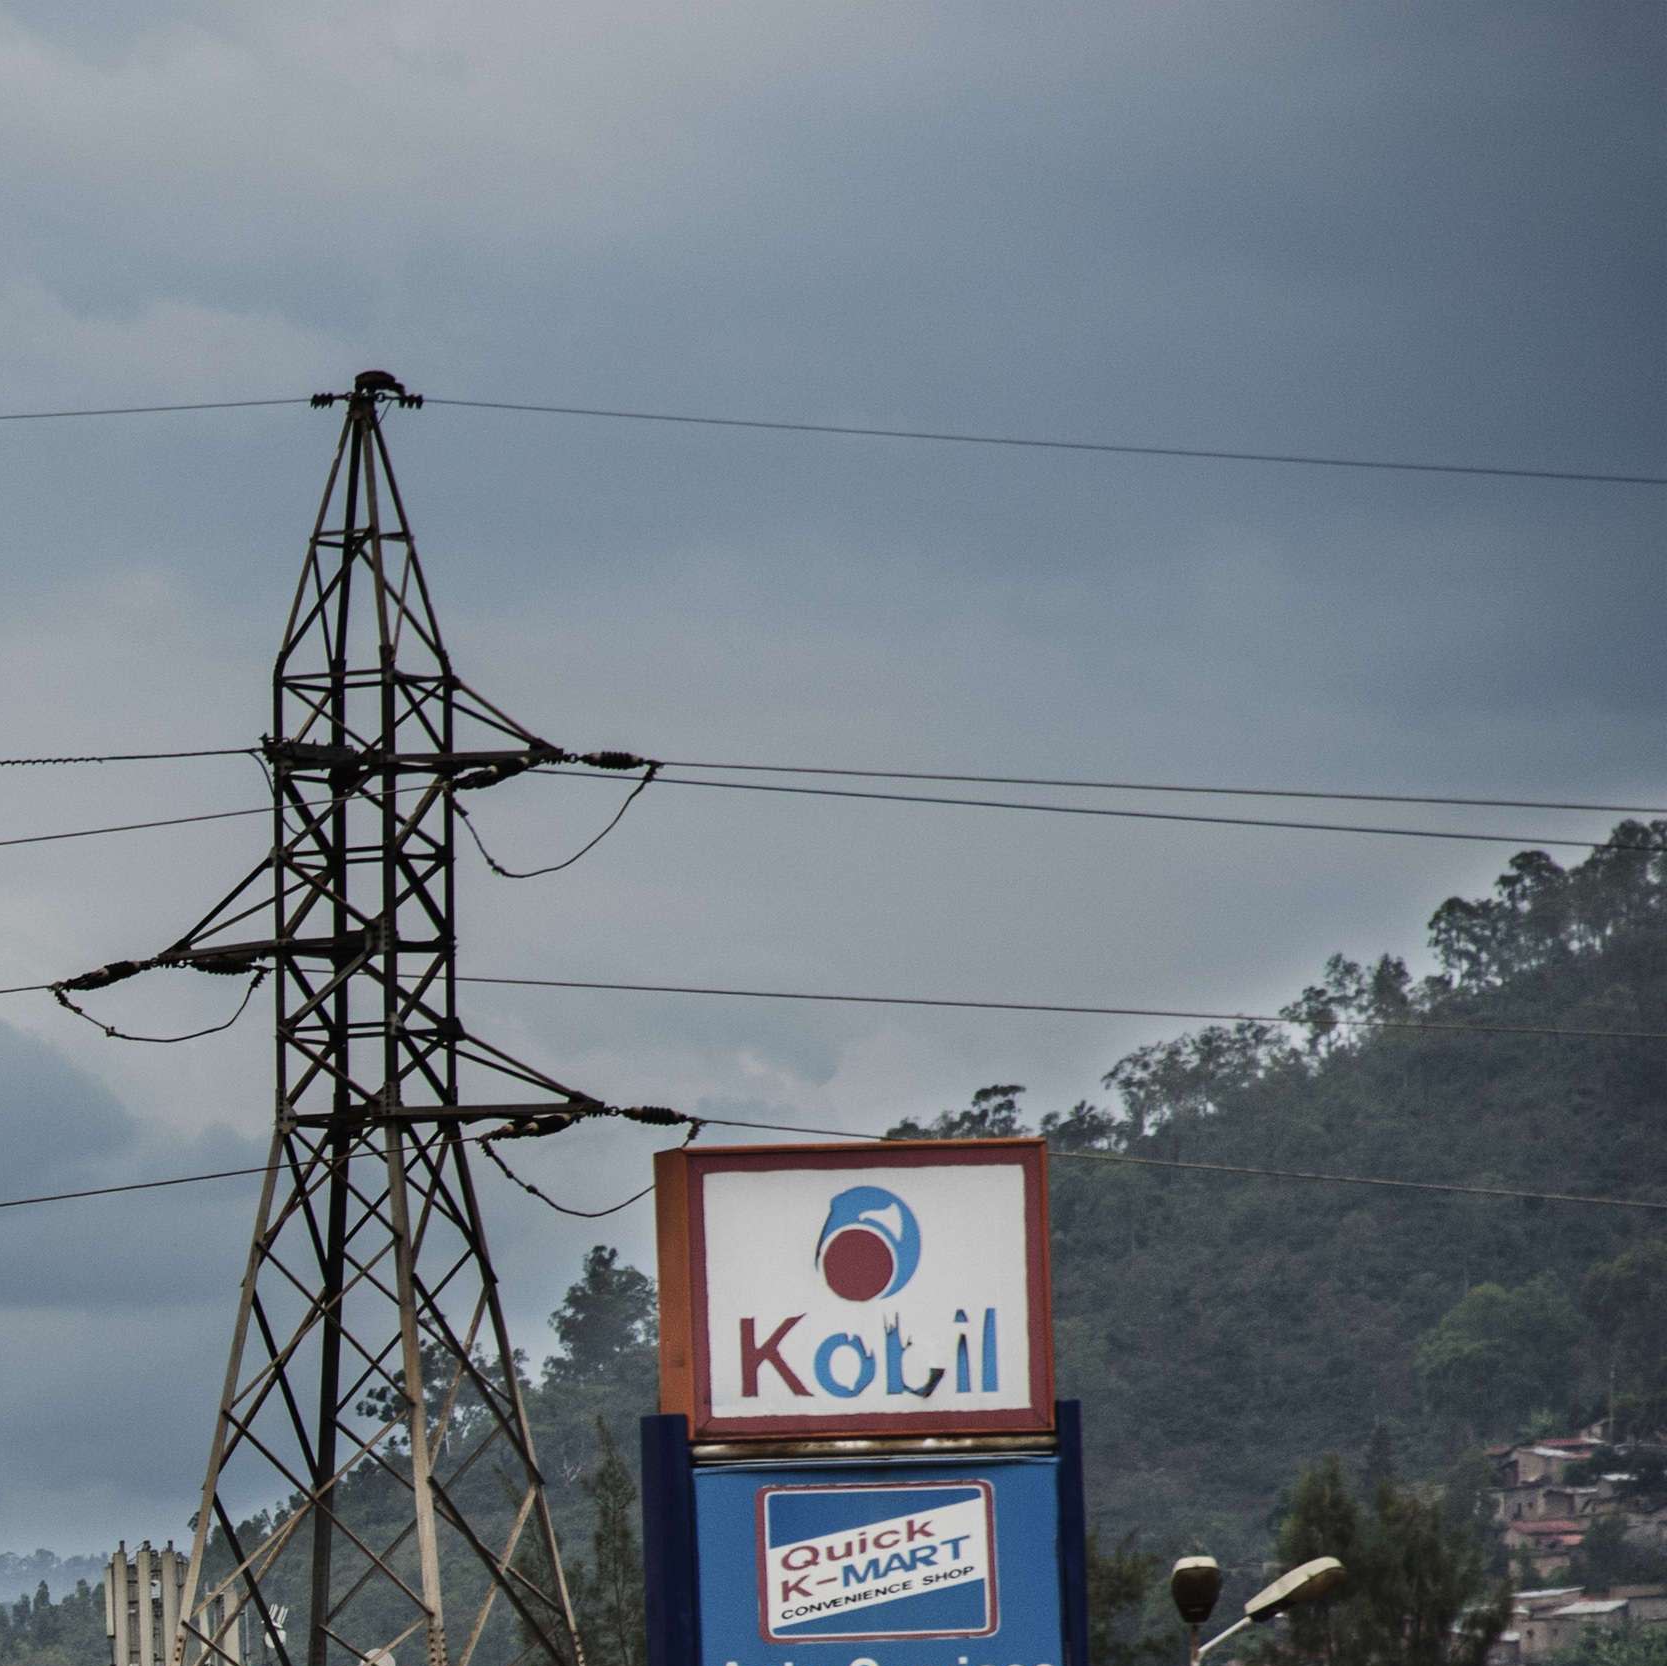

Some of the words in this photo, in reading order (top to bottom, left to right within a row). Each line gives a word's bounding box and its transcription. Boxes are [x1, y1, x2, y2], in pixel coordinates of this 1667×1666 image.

[779, 1518, 935, 1573] Quick
[781, 1535, 971, 1603] K-MART
[781, 1580, 914, 1620] CONVENIENCE
[922, 1565, 975, 1588] SHOP
